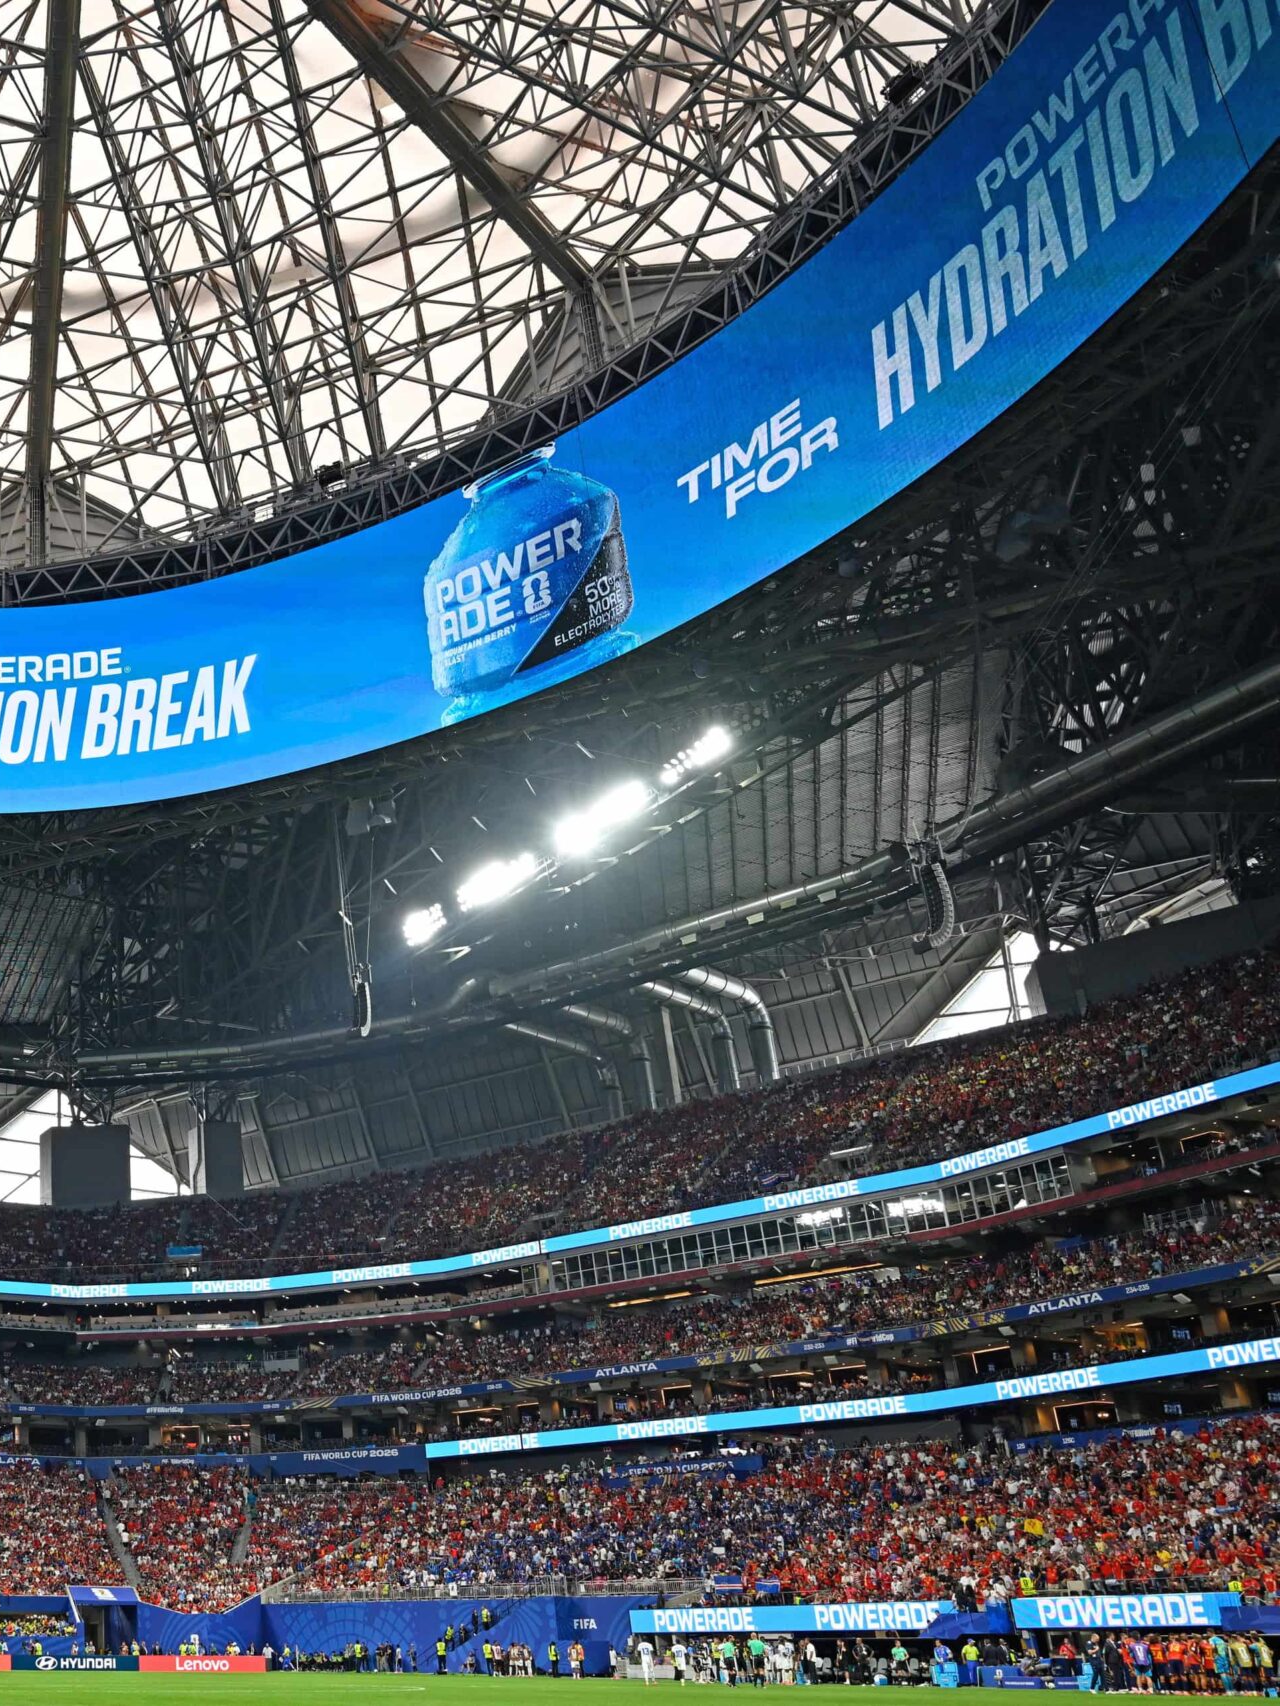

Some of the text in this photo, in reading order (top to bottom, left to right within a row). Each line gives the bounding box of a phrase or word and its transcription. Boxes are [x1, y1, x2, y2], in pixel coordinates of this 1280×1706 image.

[870, 6, 1200, 431] HYDRATION
[676, 398, 801, 503] TIME
[725, 416, 839, 519] FOR
[437, 517, 582, 612] POWER
[585, 575, 621, 603] 50%
[439, 586, 515, 647] ADE
[588, 588, 622, 618] MORE
[482, 622, 518, 644] BERRY
[80, 653, 259, 760] BREAK
[1108, 1082, 1219, 1130] POWERADE
[940, 1137, 1031, 1178] POWERADE
[764, 1180, 859, 1212] POWERADE
[609, 1212, 693, 1241] POWERADE
[472, 1239, 547, 1266] POWERADE
[191, 1278, 272, 1294] POWERADE
[332, 1263, 412, 1284] POWERADE
[51, 1284, 128, 1298] POWERADE
[1028, 1292, 1103, 1315] ATLANTA
[595, 1361, 658, 1378] ATLANTA
[996, 1366, 1101, 1400] POWERADE
[372, 1387, 462, 1403] FIFA WORLD CUP 2026
[800, 1396, 908, 1423] POWERADE
[617, 1416, 708, 1440] POWERADE
[303, 1448, 399, 1461] FIFA WORLD CUP 2026
[459, 1433, 540, 1455] POWERADE
[573, 1618, 598, 1630] FIFA
[653, 1607, 757, 1632] POWERADE
[814, 1602, 941, 1630] POWERADE
[1036, 1595, 1209, 1627] POWERADE
[60, 1657, 117, 1669] HYUNDAI
[175, 1656, 230, 1671] Lenovo
